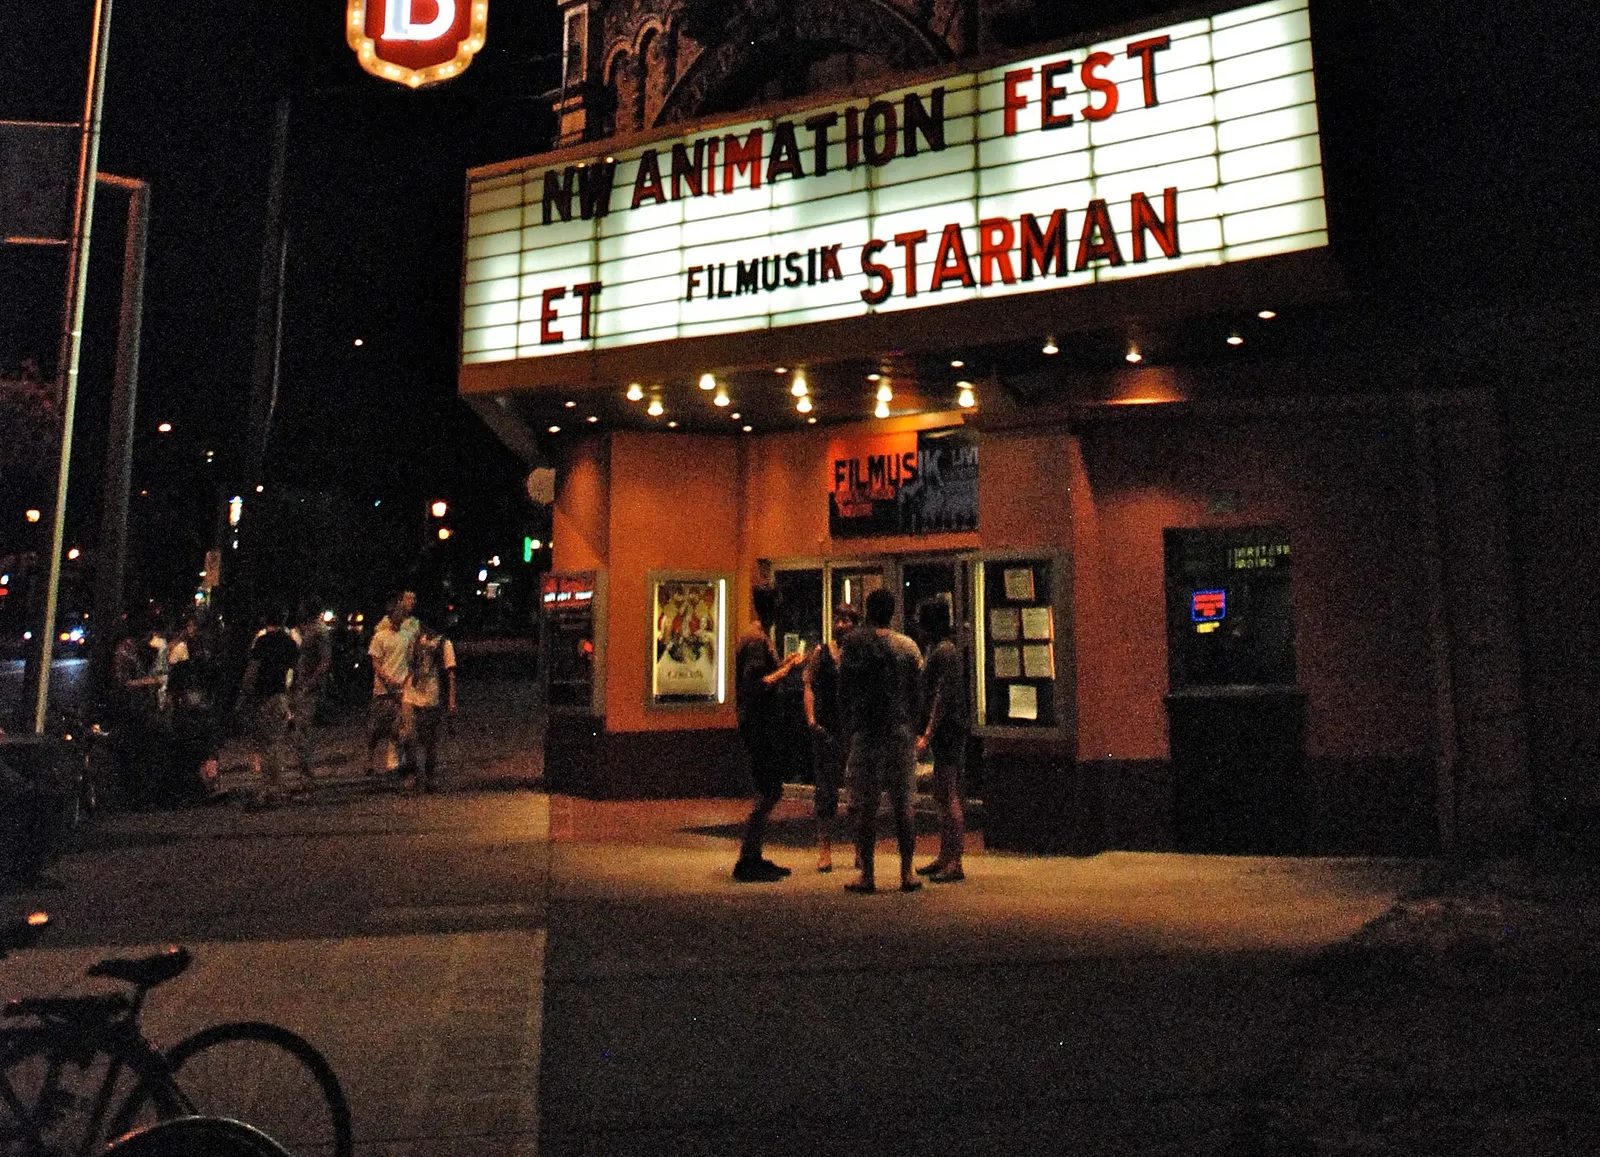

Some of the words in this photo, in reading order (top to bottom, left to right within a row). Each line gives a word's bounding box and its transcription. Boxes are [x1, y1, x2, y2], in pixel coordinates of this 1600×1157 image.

[542, 161, 616, 225] NW
[631, 87, 949, 210] ANIMATION
[1003, 35, 1171, 136] FEST
[686, 247, 844, 302] FILMUSIK
[859, 186, 1181, 305] STARMAN
[540, 281, 602, 345] ET
